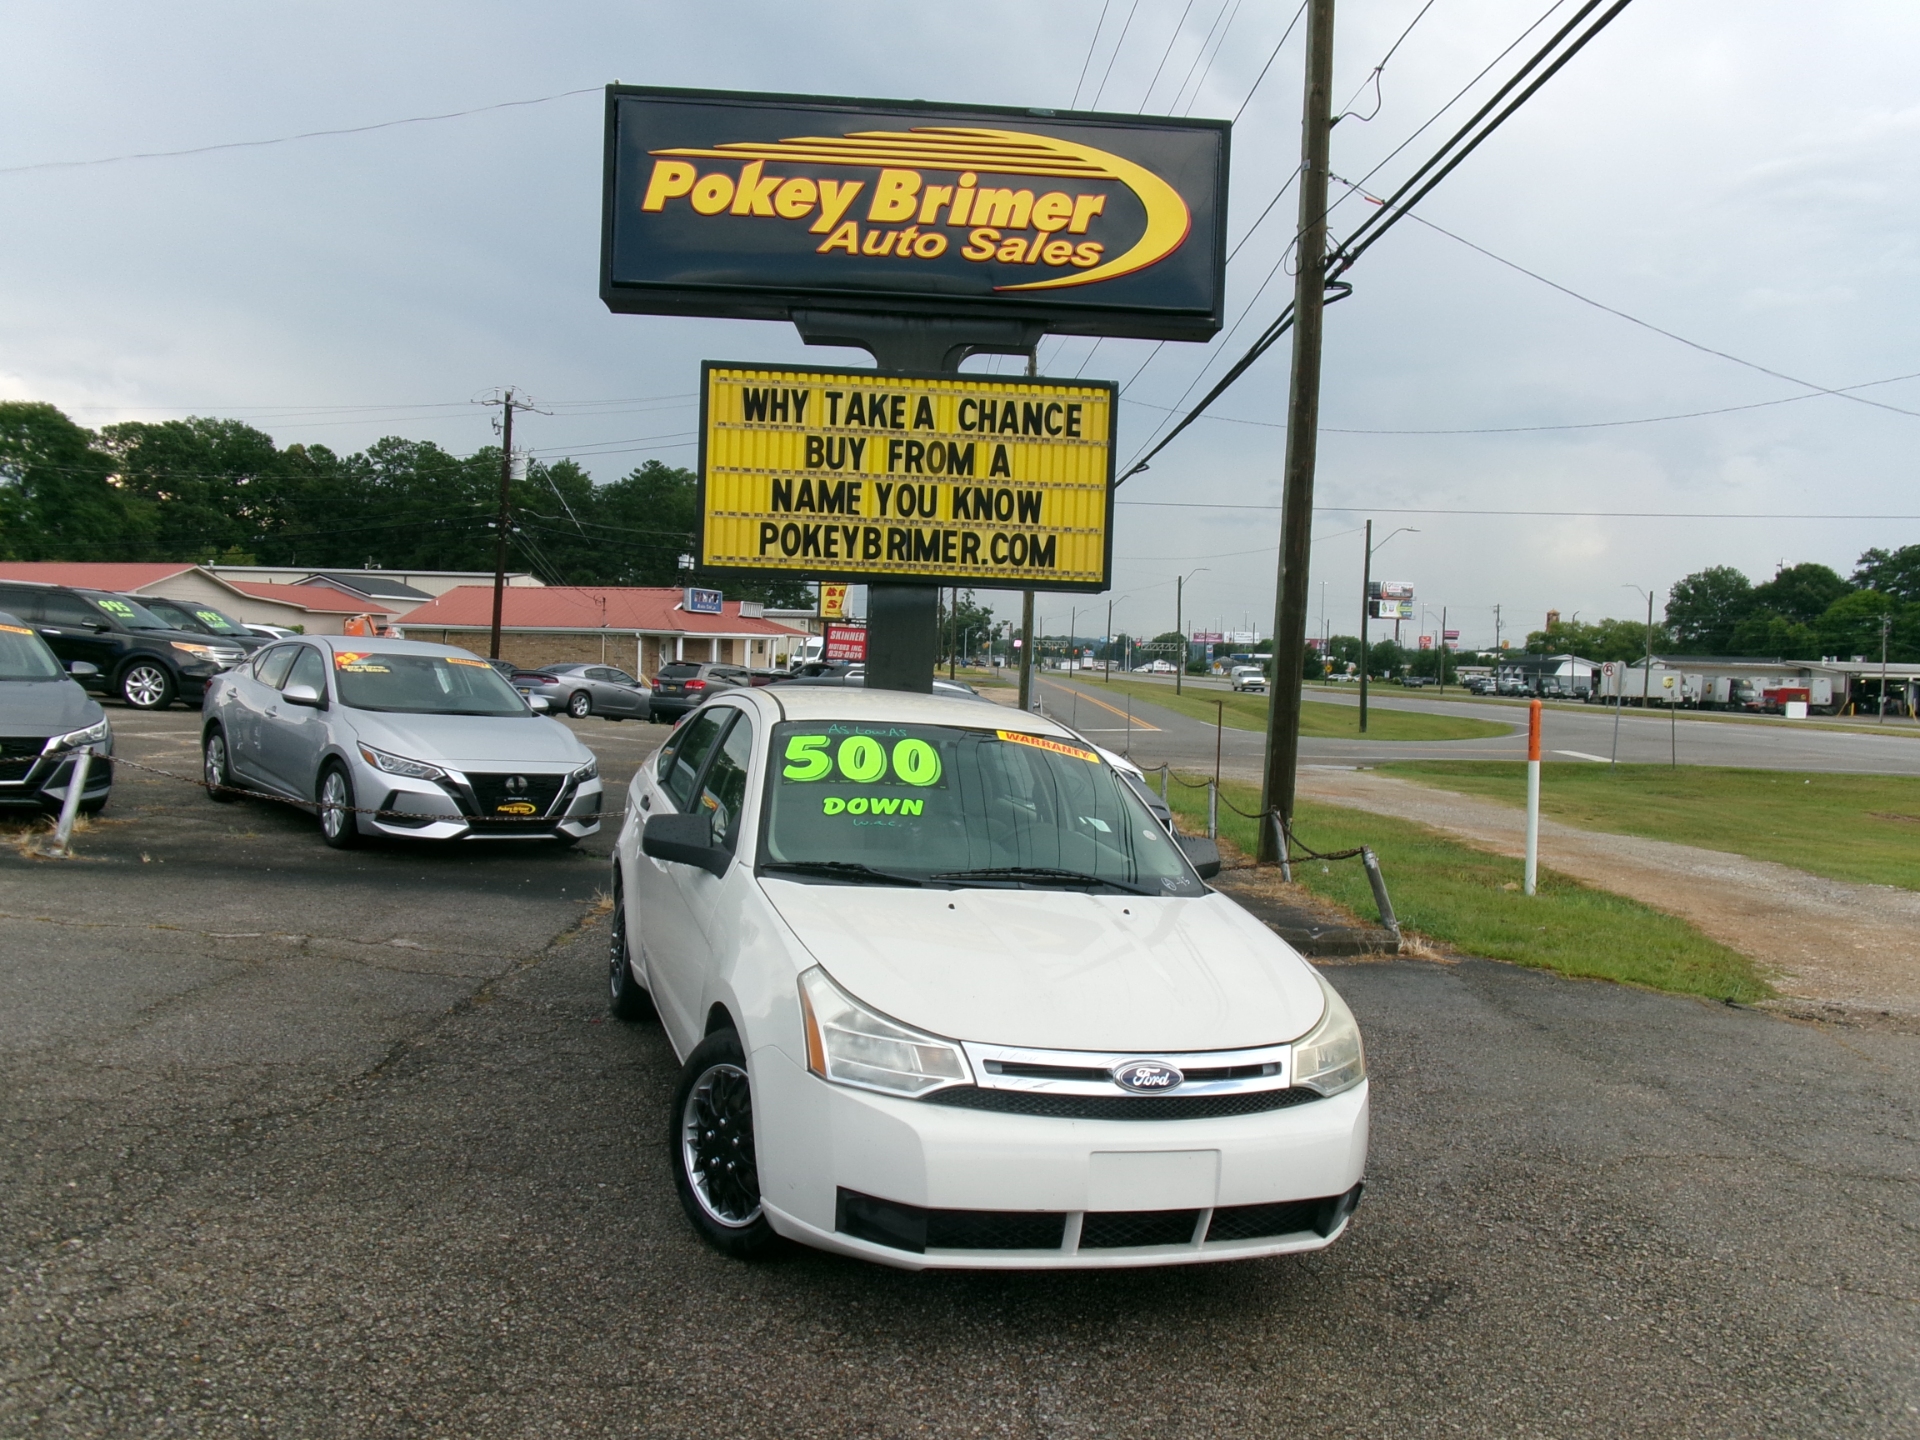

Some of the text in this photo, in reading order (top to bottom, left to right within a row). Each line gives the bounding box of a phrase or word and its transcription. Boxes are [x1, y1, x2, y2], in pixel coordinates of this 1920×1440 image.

[642, 159, 1105, 235] Pokey Brimer
[817, 221, 1104, 267] Auto Sales
[742, 387, 1082, 437] WHY TAKE A CHANCE
[805, 435, 1011, 478] BUY FROM A
[771, 478, 1043, 524] NAME YOU KNOW
[759, 522, 1056, 568] POKEYBRIMER.COM
[830, 630, 865, 641] SKINNER
[783, 735, 942, 787] 500
[1005, 731, 1090, 760] WARRANTY
[822, 796, 924, 816] DOWN
[1132, 1068, 1171, 1087] Ford
